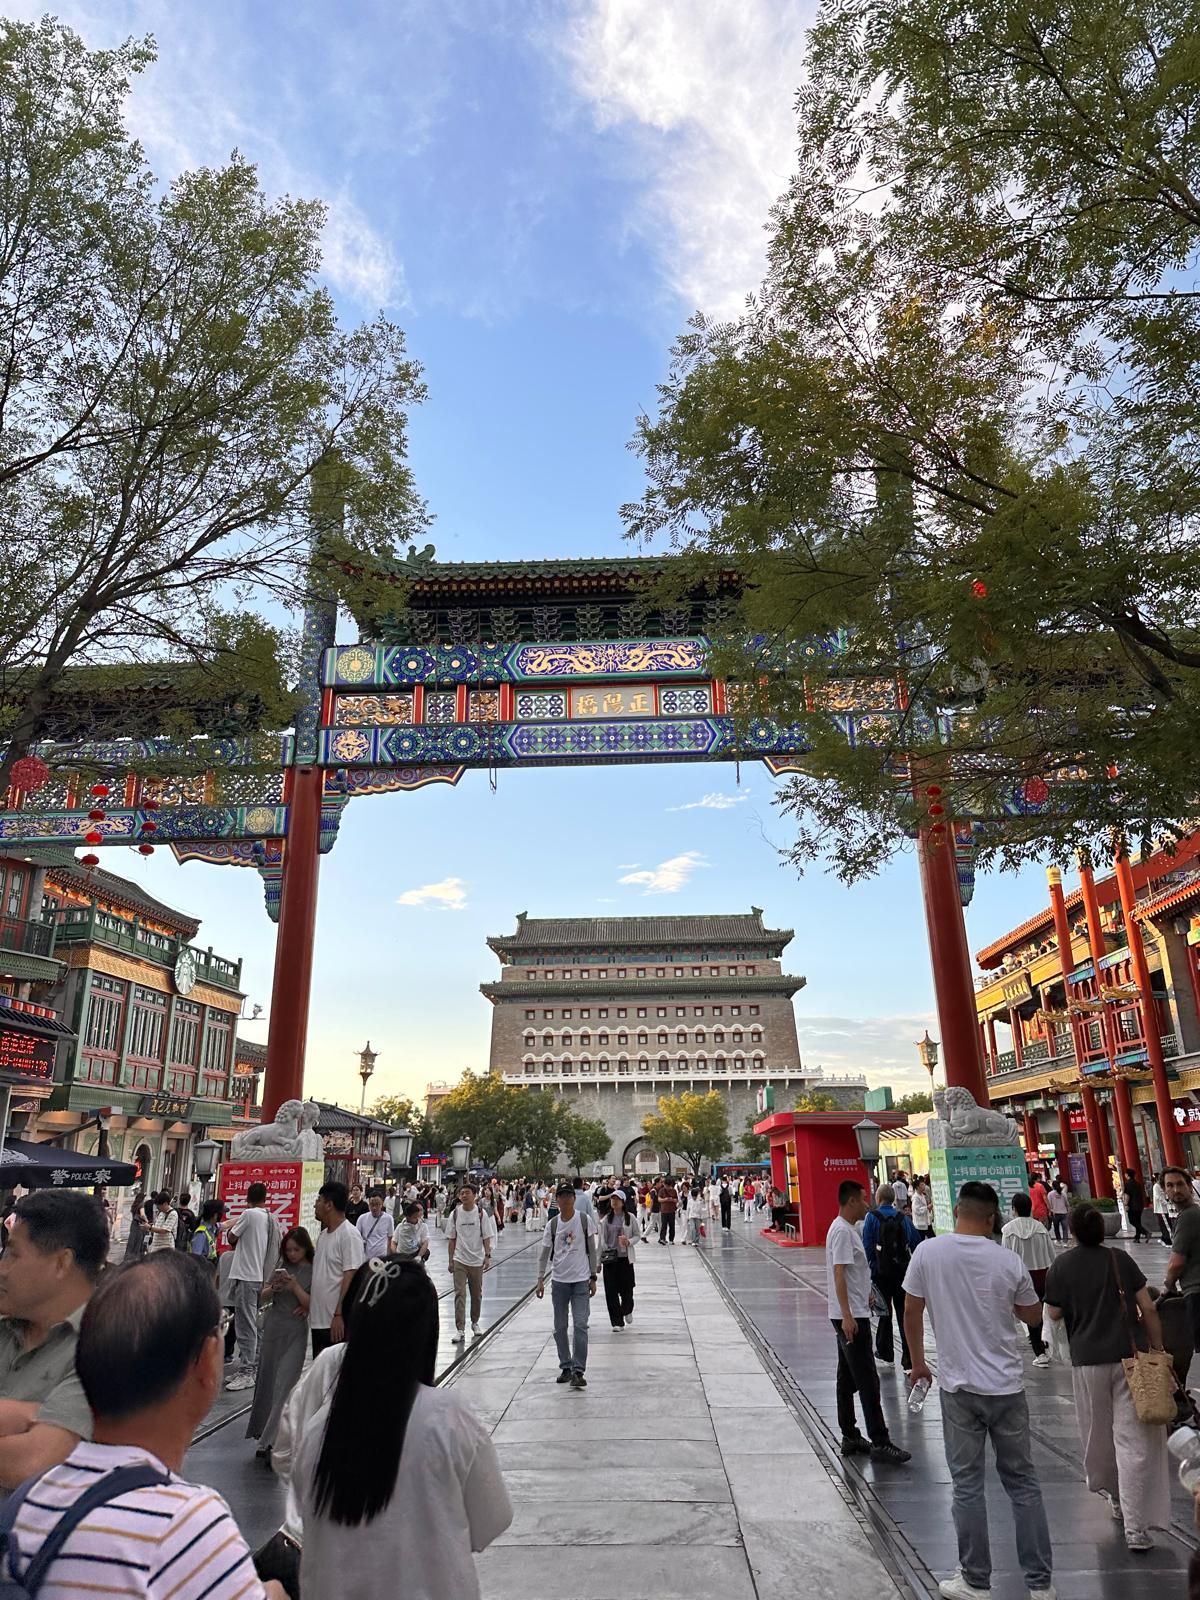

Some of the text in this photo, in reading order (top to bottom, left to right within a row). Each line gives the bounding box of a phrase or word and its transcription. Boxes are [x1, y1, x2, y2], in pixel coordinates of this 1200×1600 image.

[50, 1168, 112, 1185] 警 POLICE 察
